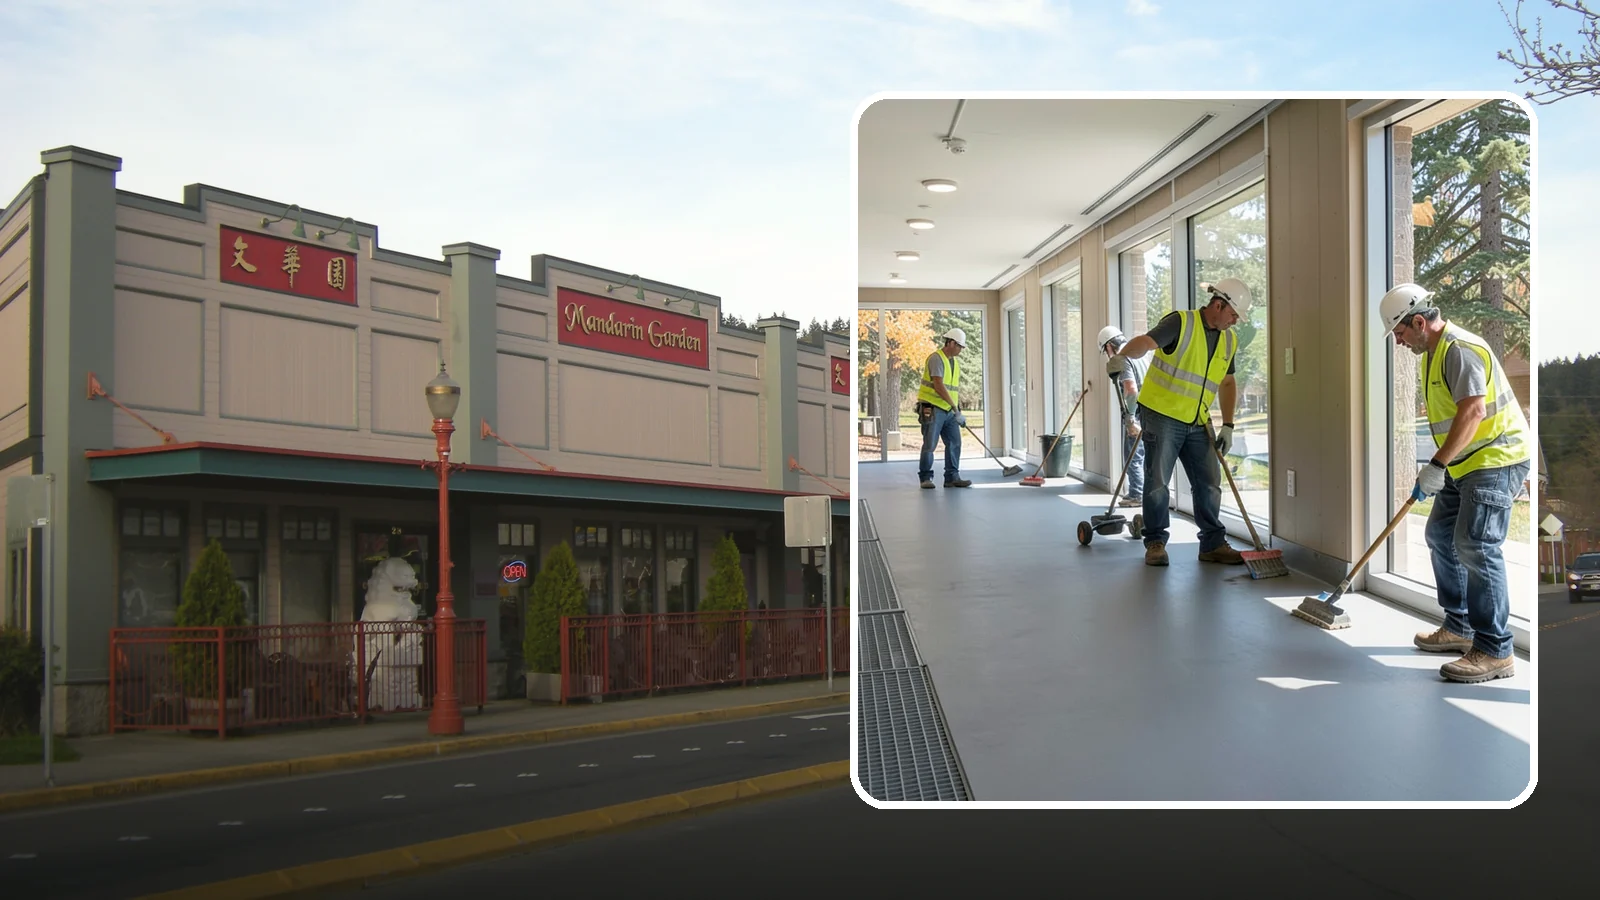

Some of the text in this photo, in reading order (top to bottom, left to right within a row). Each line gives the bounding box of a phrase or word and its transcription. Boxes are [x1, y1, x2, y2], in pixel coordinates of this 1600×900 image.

[231, 236, 346, 290] 文華園
[565, 303, 701, 352] Mandarin Garden
[503, 565, 527, 578] OPEN
